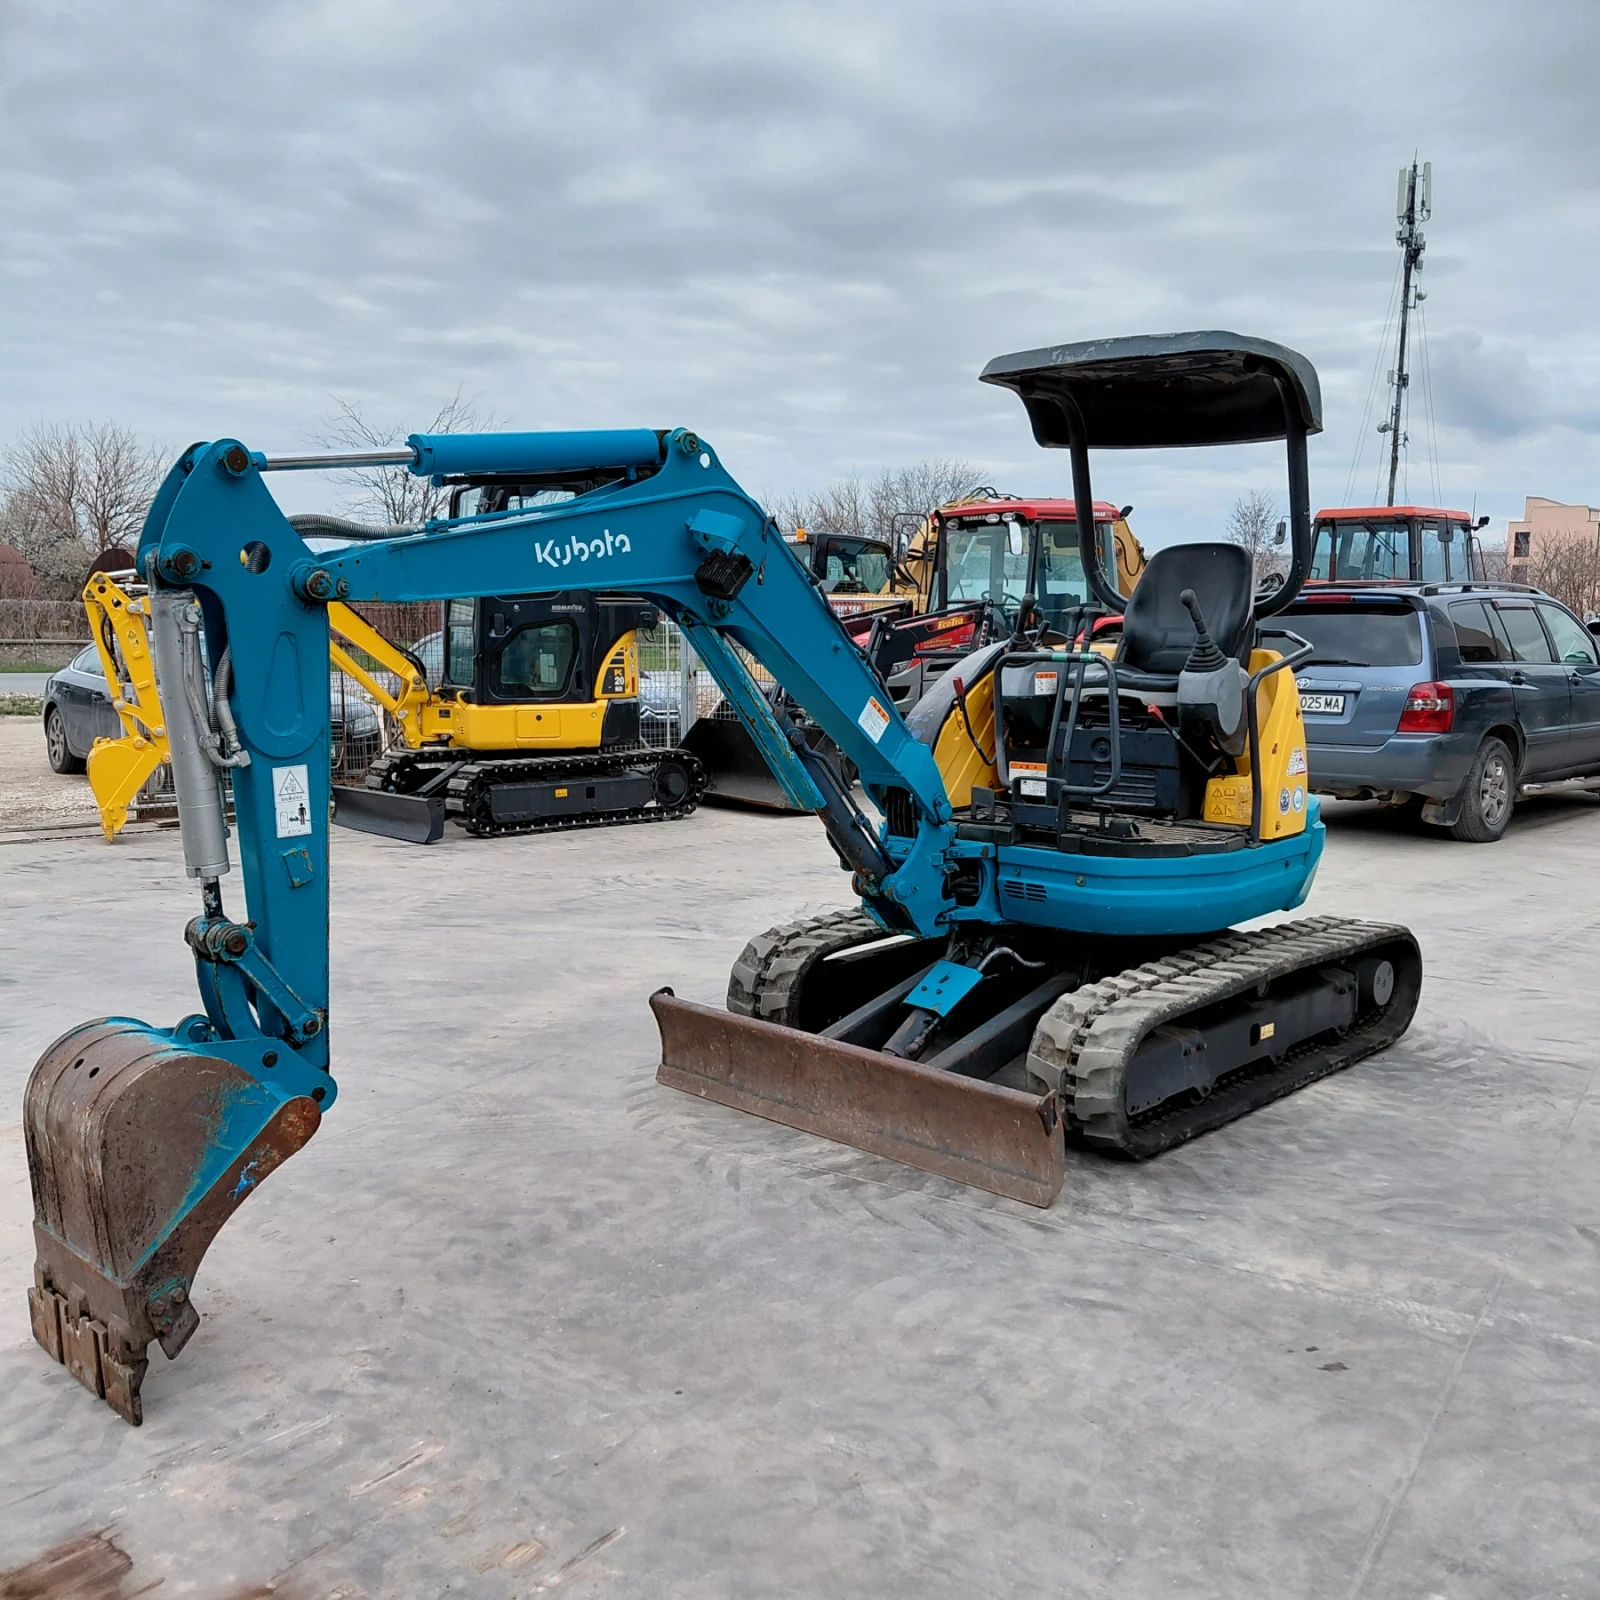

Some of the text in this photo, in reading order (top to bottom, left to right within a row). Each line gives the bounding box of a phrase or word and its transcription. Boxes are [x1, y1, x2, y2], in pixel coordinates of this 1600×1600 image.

[534, 529, 632, 568] Kubota
[551, 603, 583, 612] KOMATSU
[937, 617, 964, 629] EcoTra
[614, 676, 624, 685] 20
[1300, 696, 1340, 710] 025 MA
